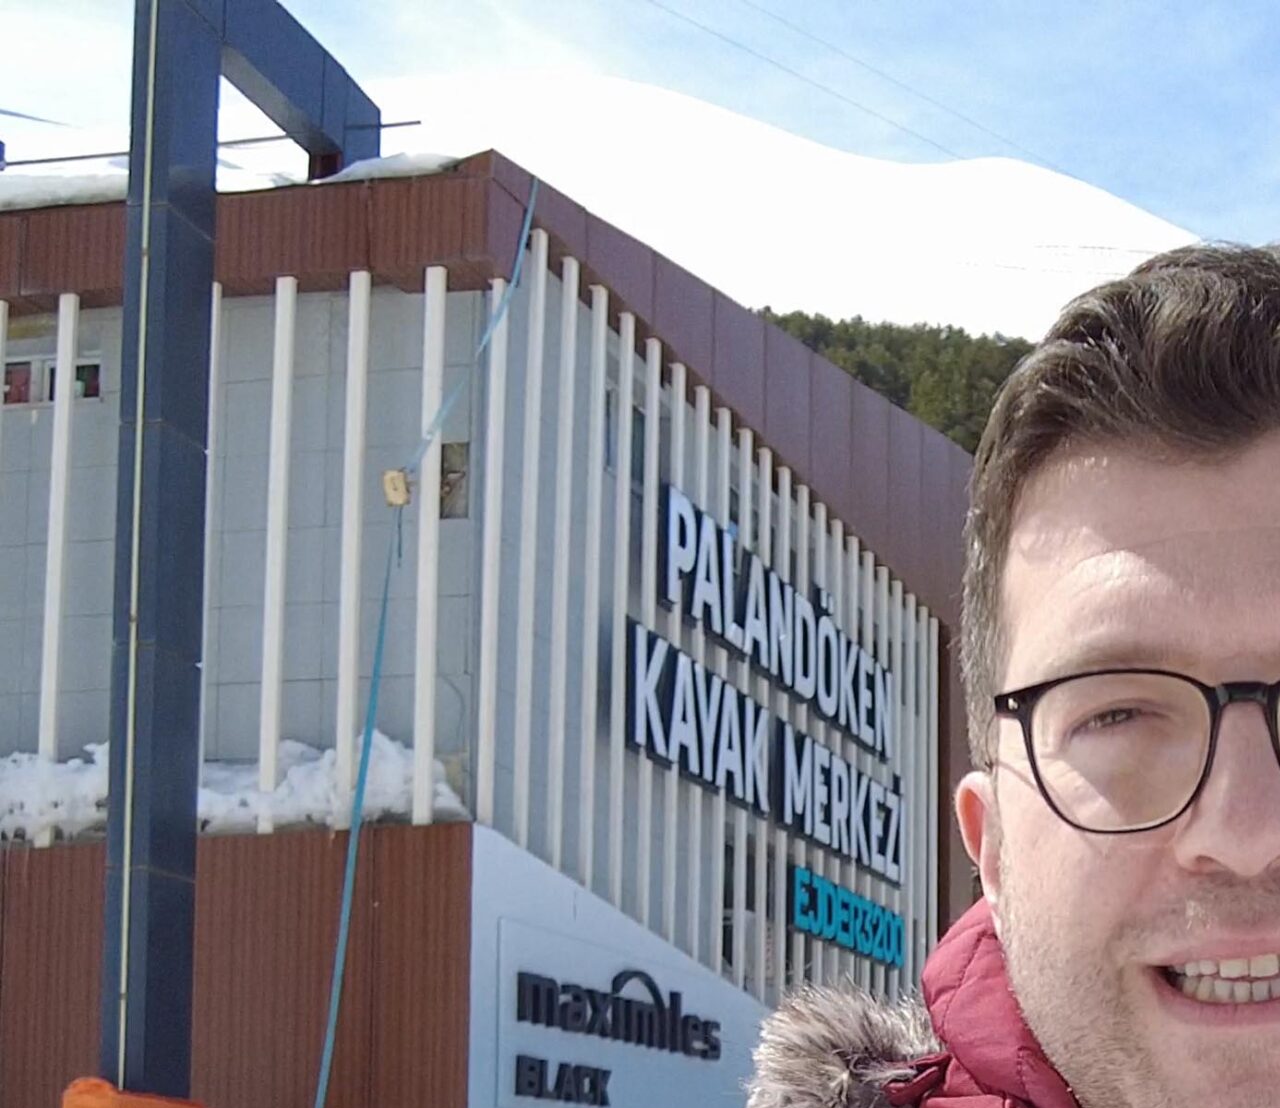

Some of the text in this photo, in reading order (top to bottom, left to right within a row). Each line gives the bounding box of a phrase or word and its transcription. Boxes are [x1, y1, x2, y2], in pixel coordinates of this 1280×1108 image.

[668, 484, 893, 760] PALANDÖKEN
[635, 624, 770, 814] KAYAK
[793, 866, 905, 968] EJDER3200
[516, 970, 722, 1061] maximiles
[514, 1053, 613, 1107] BLACK
